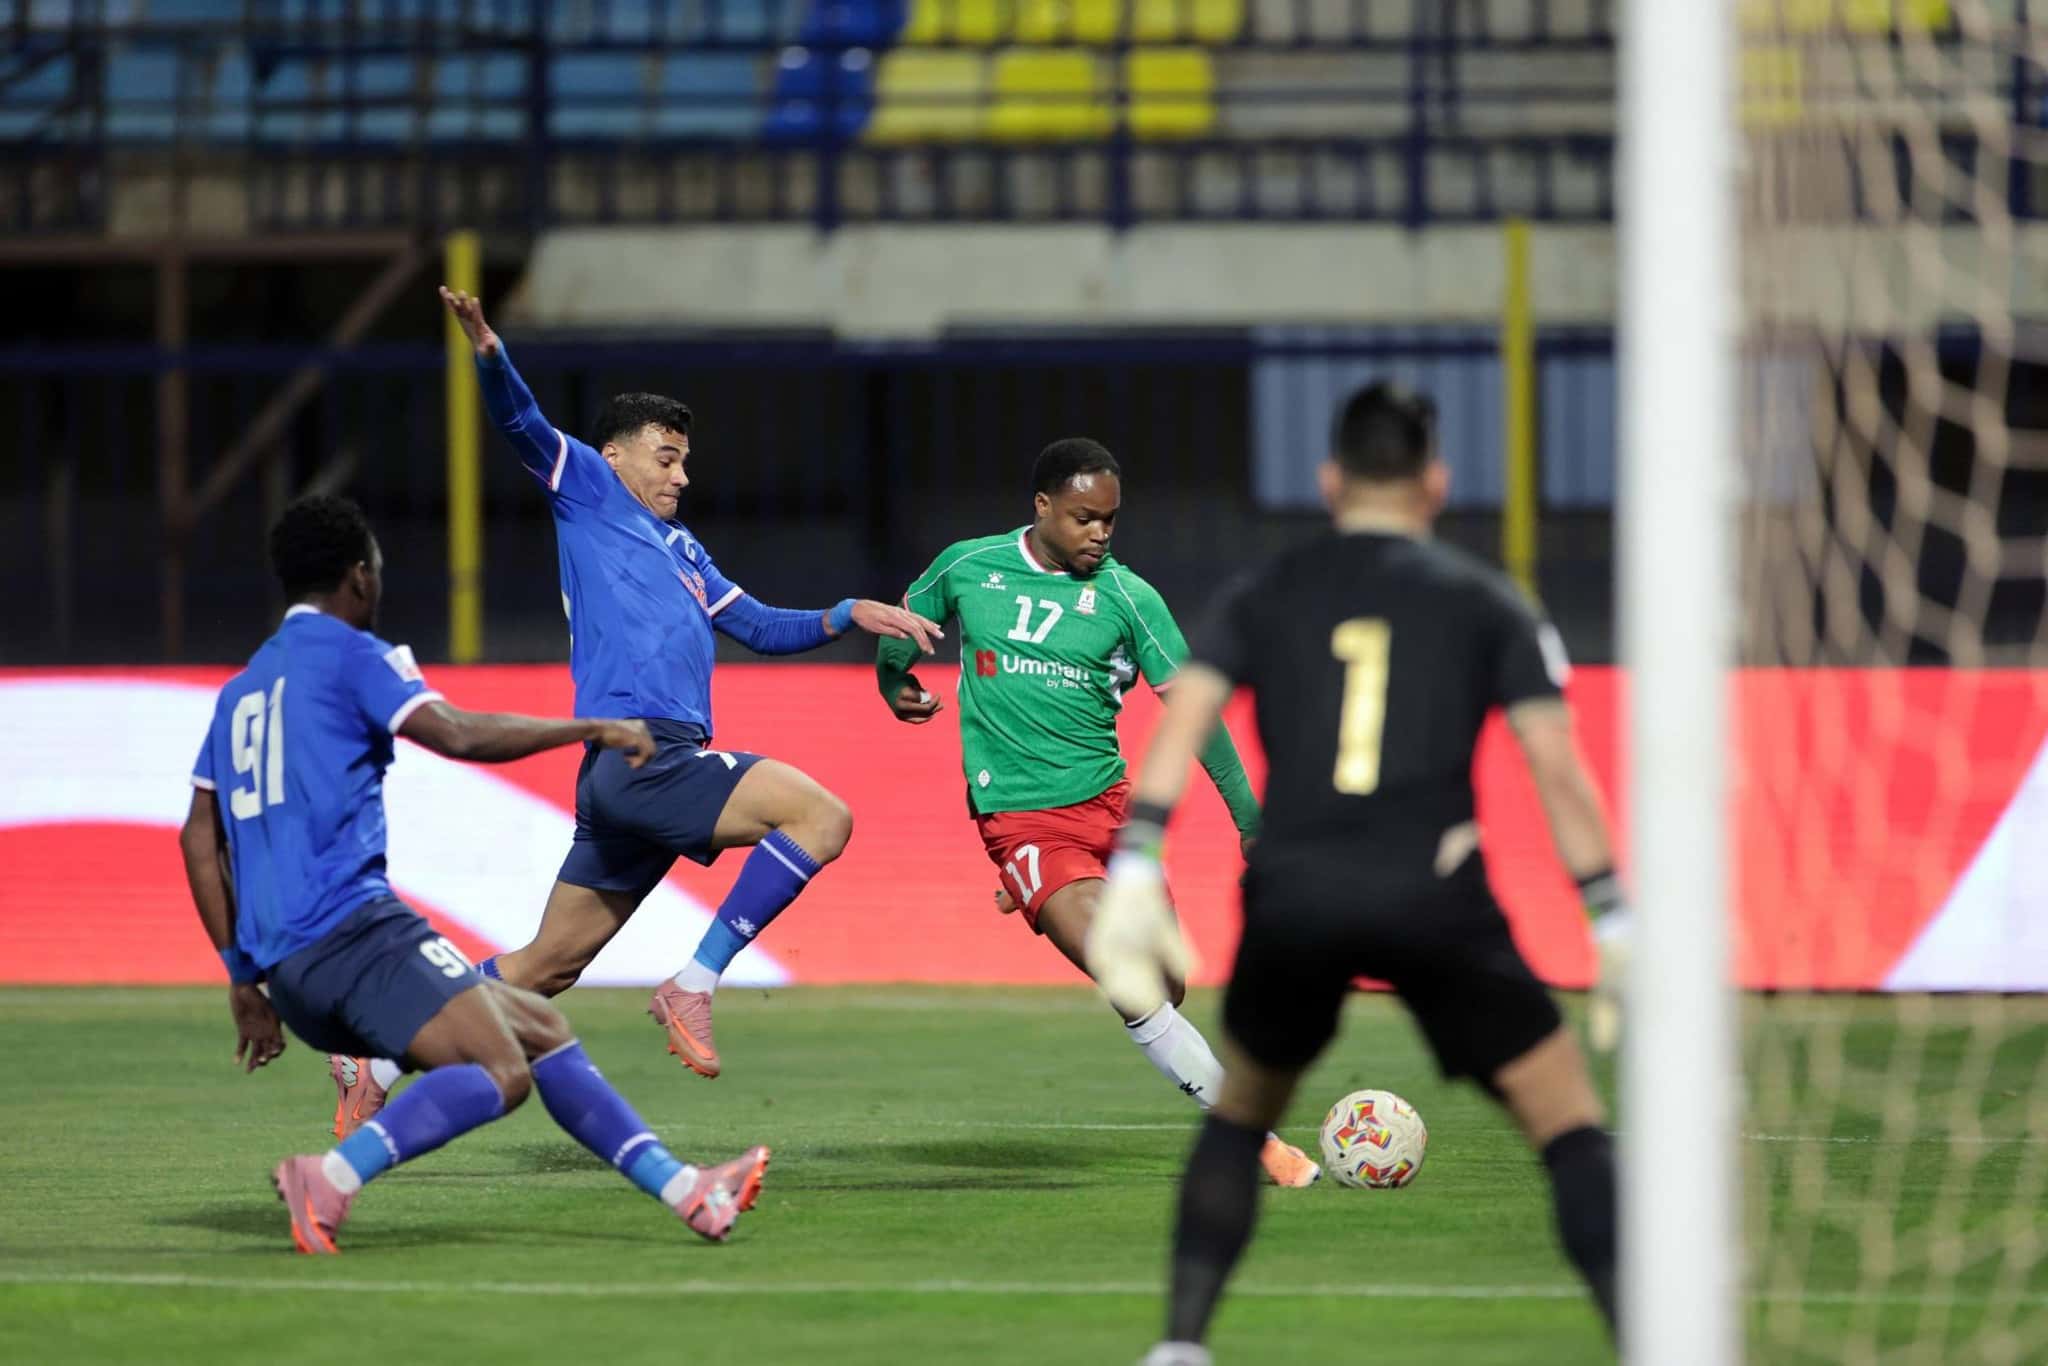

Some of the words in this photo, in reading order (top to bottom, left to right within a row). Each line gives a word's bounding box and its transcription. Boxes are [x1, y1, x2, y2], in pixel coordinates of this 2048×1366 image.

[1007, 595, 1064, 644] 17
[1046, 679, 1059, 689] by
[1331, 617, 1392, 796] 1
[231, 677, 286, 820] 91
[1005, 844, 1042, 905] 17
[419, 937, 474, 978] 91
